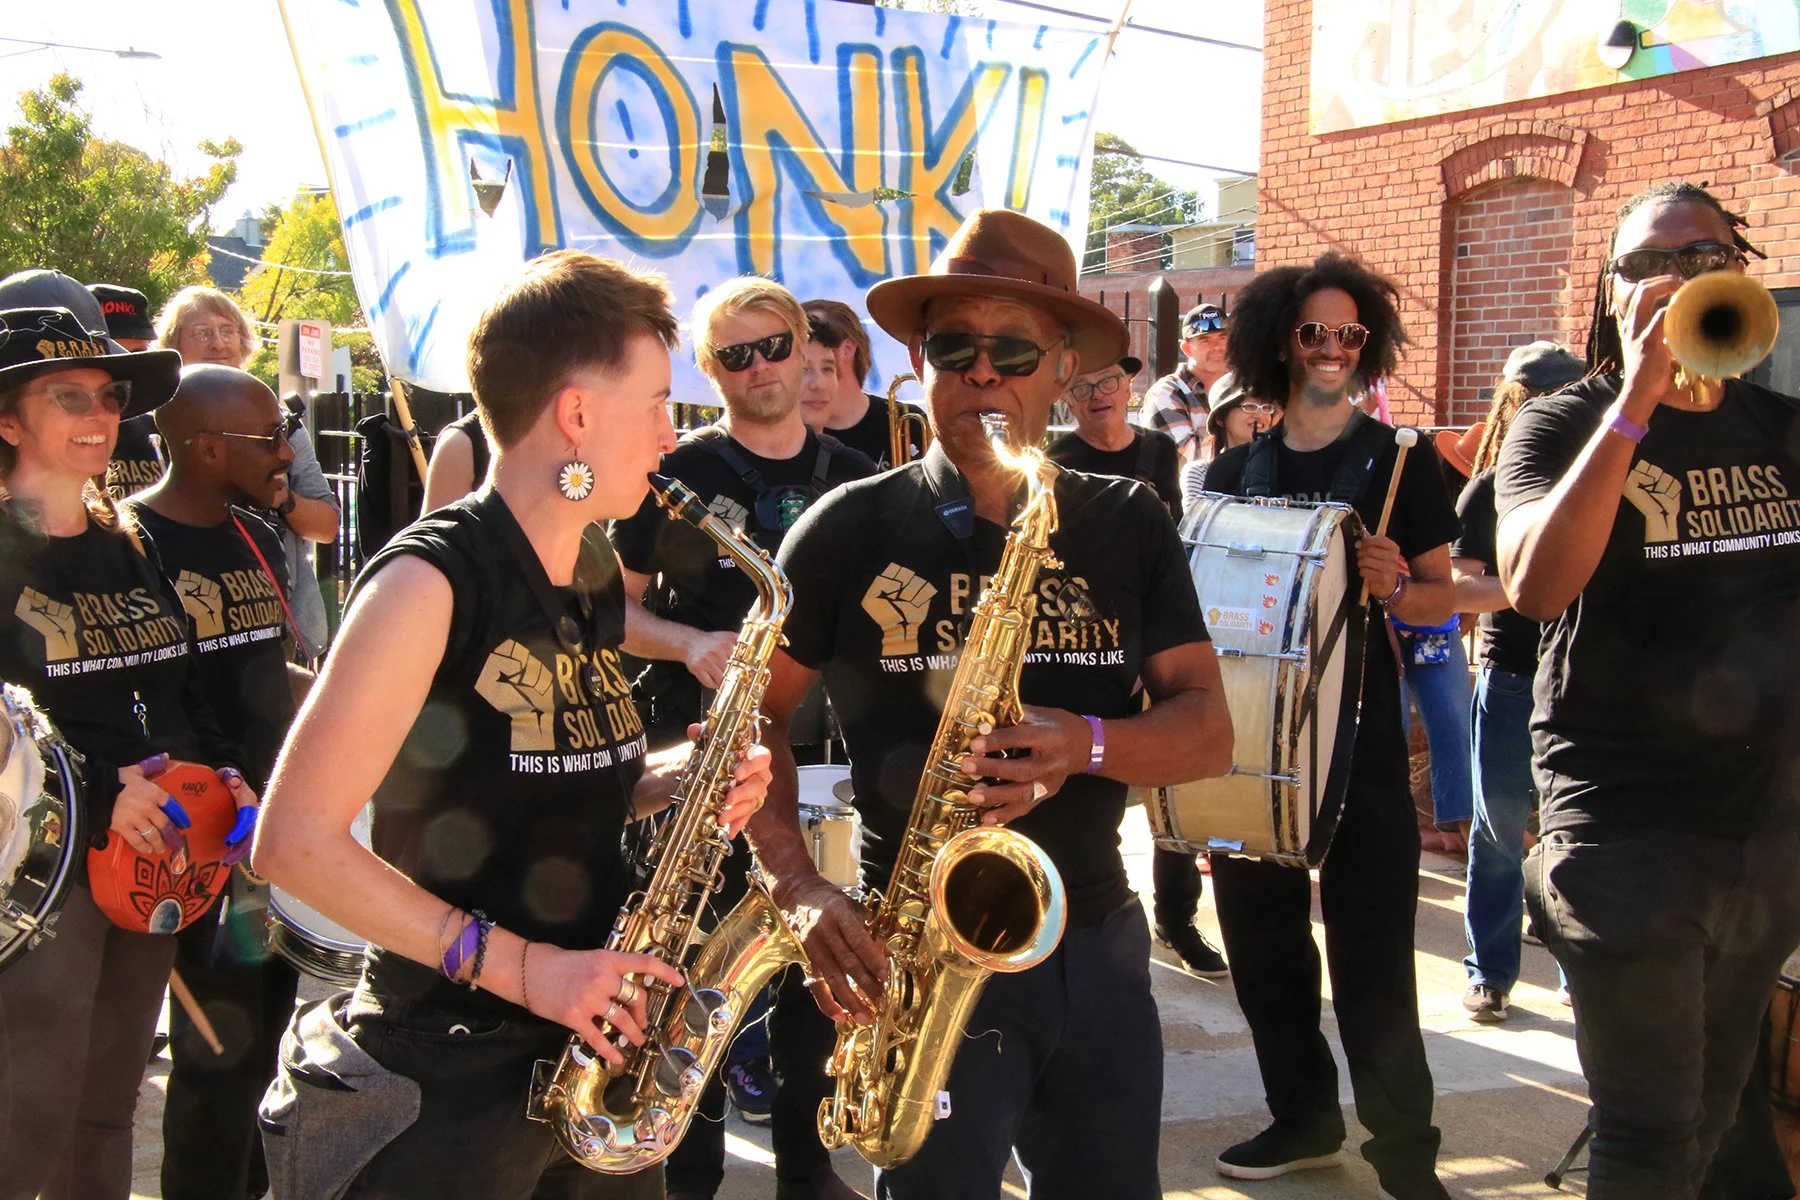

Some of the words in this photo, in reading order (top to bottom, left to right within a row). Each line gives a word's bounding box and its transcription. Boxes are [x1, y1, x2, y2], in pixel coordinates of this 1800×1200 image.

[117, 460, 162, 483] RASS
[1686, 465, 1788, 507] BRASS
[1686, 499, 1800, 538] SOLIDARIT
[1644, 545, 1668, 559] THIS
[1670, 544, 1681, 558] IS
[1682, 541, 1711, 556] WHAT
[1713, 534, 1771, 553] COMMUNITY
[1773, 530, 1800, 546] LOOKS
[221, 569, 277, 602] BRAS
[72, 588, 160, 625] BRASS
[197, 639, 218, 653] THIS
[219, 637, 228, 649] IS
[228, 632, 249, 647] WHAT
[46, 663, 70, 677] THIS
[72, 661, 80, 674] IS
[82, 659, 106, 672] WHAT
[153, 646, 177, 661] LOOKS
[880, 658, 908, 673] THIS
[910, 657, 924, 671] IS
[926, 655, 958, 670] WHA
[1100, 650, 1125, 665] LIKE
[510, 754, 544, 774] THIS
[548, 756, 560, 774] IS
[562, 753, 591, 773] WHAT
